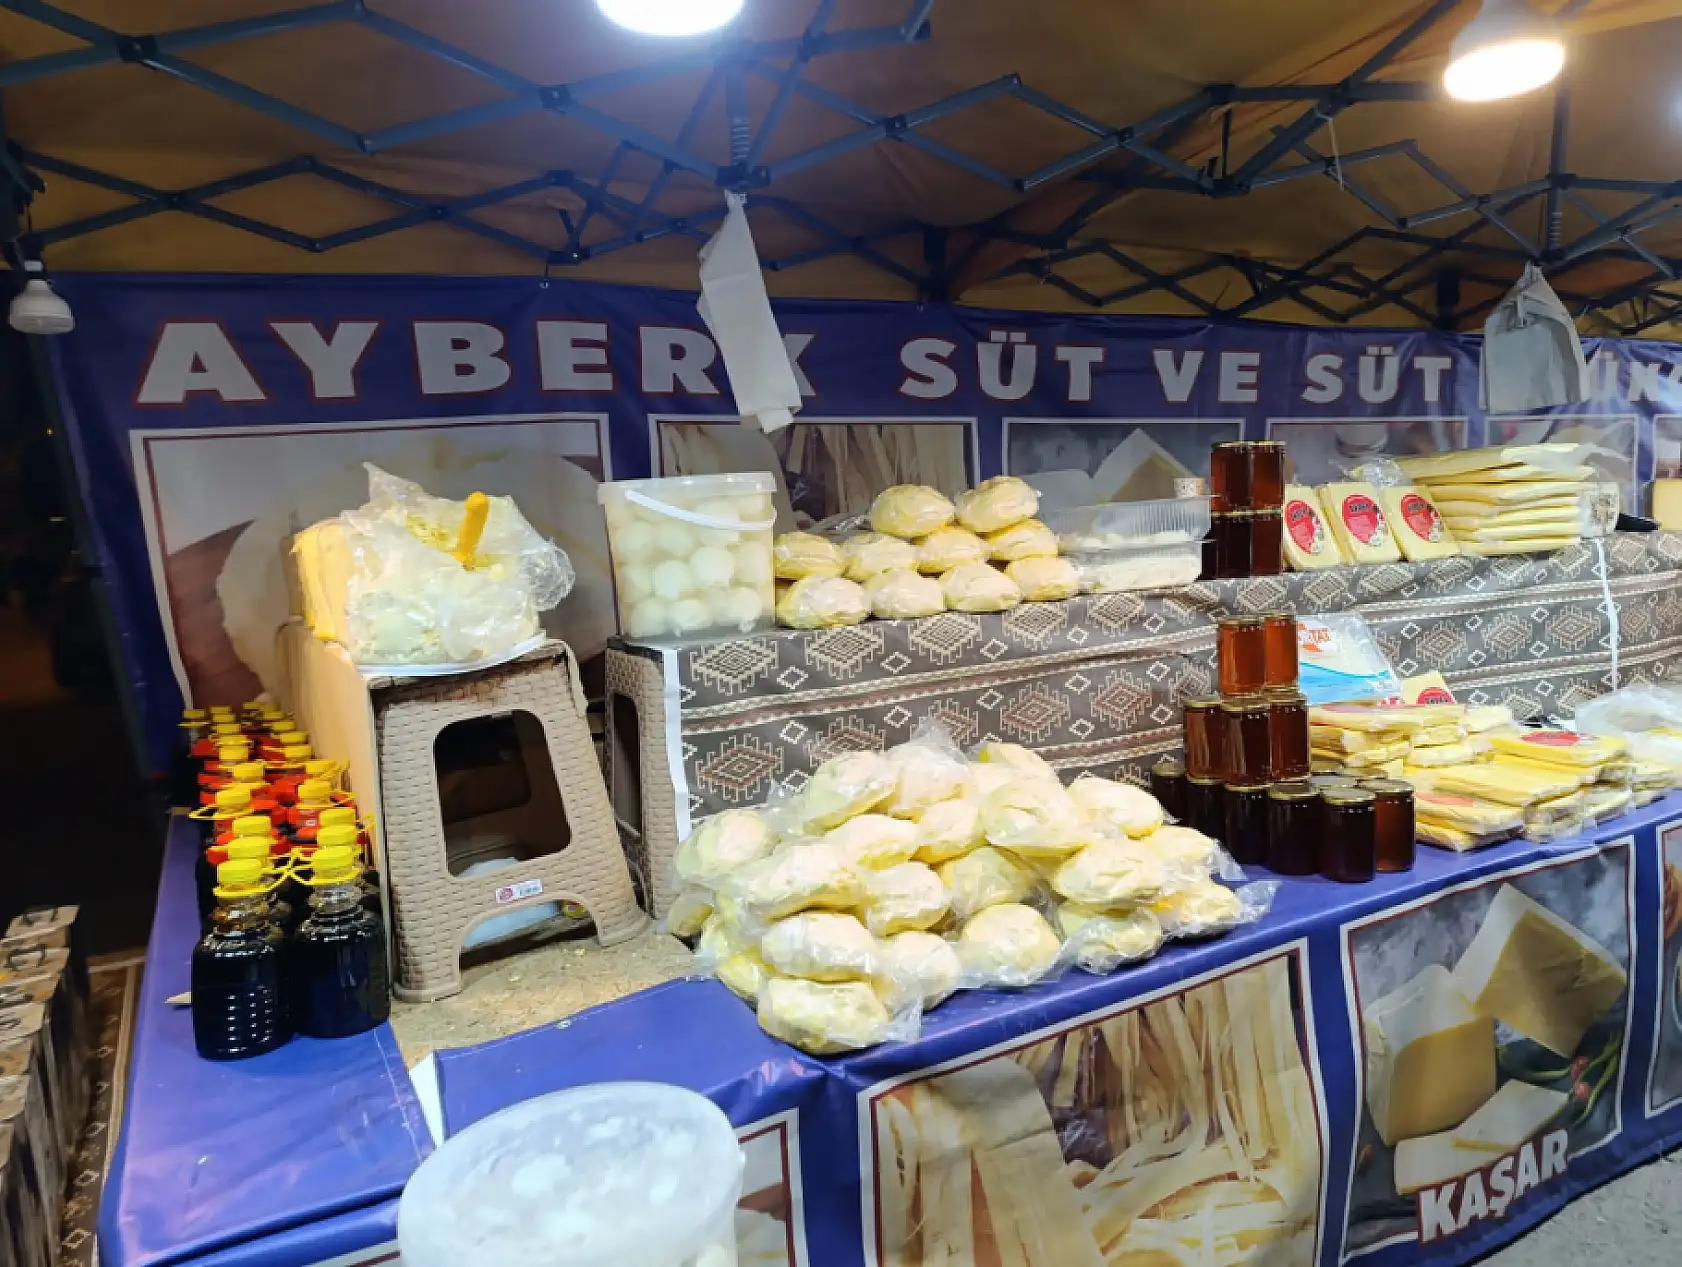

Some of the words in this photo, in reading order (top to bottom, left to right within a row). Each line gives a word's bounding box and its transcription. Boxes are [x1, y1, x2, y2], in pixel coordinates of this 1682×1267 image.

[899, 330, 1106, 402] SÜT
[1153, 349, 1260, 404] VE
[1302, 345, 1453, 405] SÜT
[1419, 1129, 1569, 1243] KAŞAR
